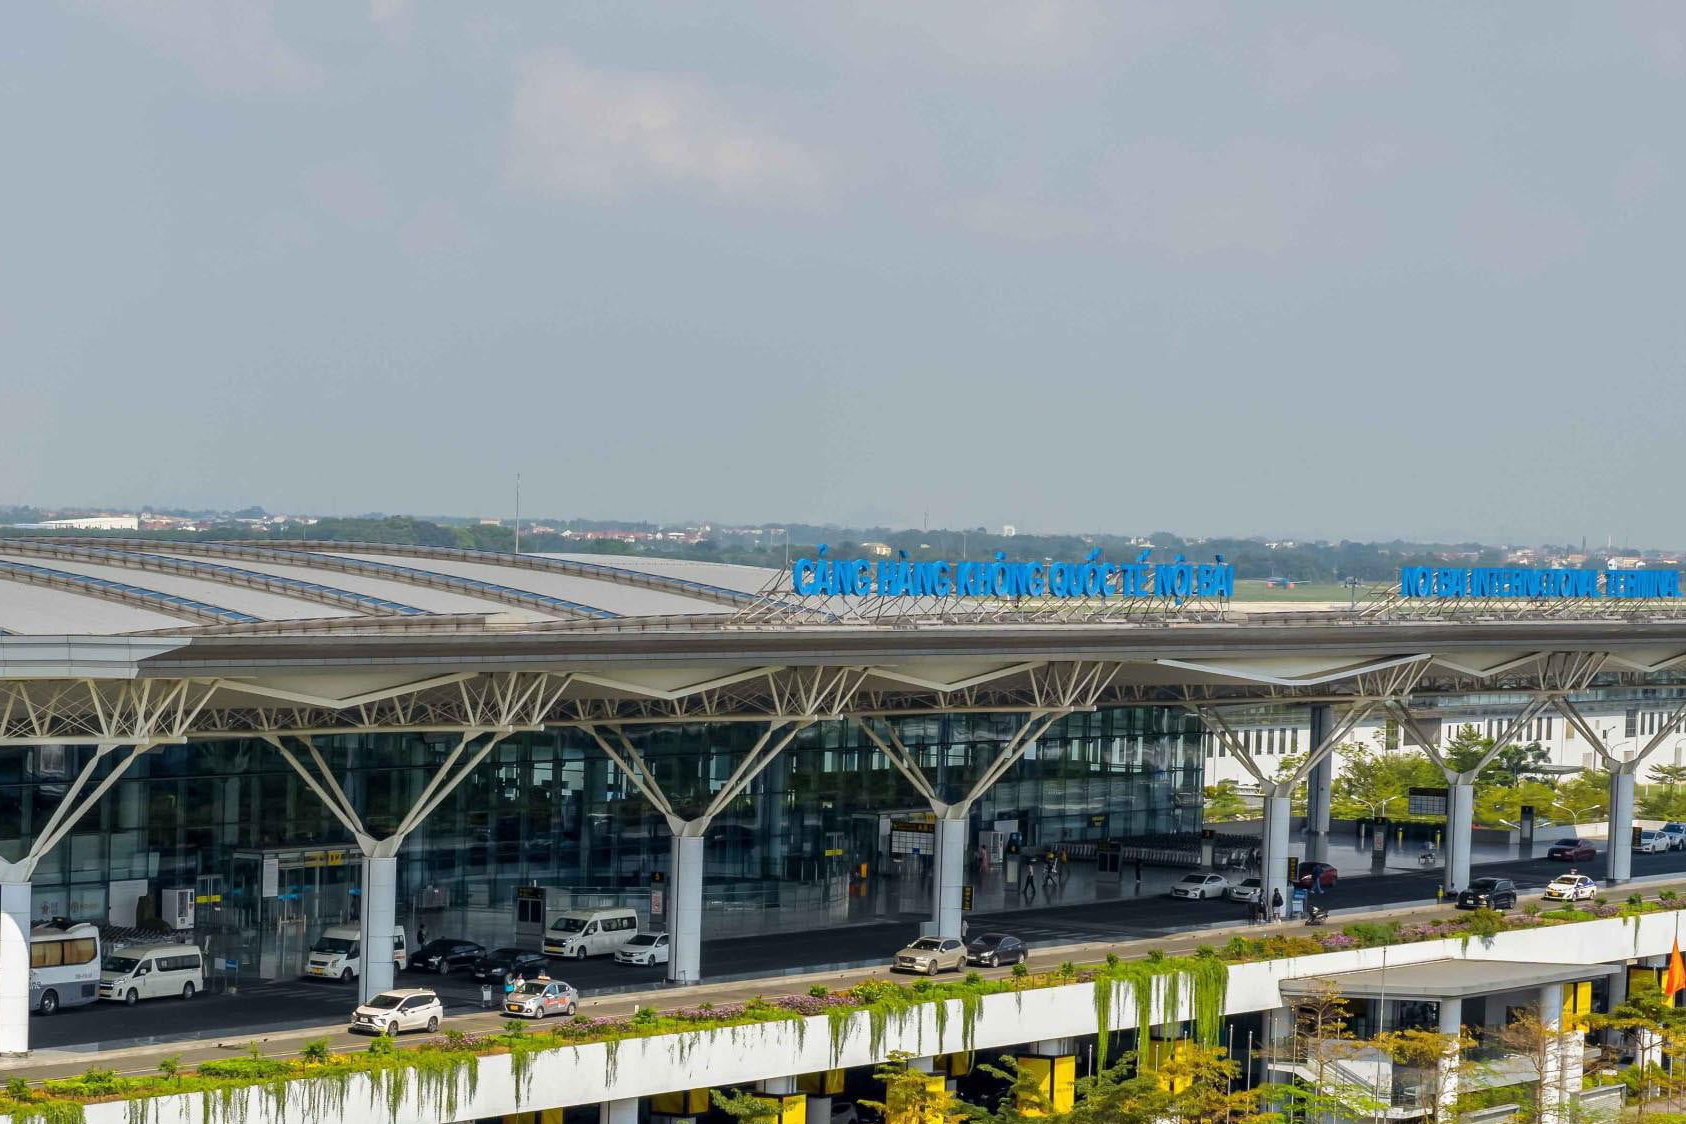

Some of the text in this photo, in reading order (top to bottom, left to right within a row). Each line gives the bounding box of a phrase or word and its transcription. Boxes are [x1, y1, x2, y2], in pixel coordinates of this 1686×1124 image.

[793, 543, 1234, 606] CẢNG HÀNG KHÔNG QUỐC TẾ NỘI BÀI
